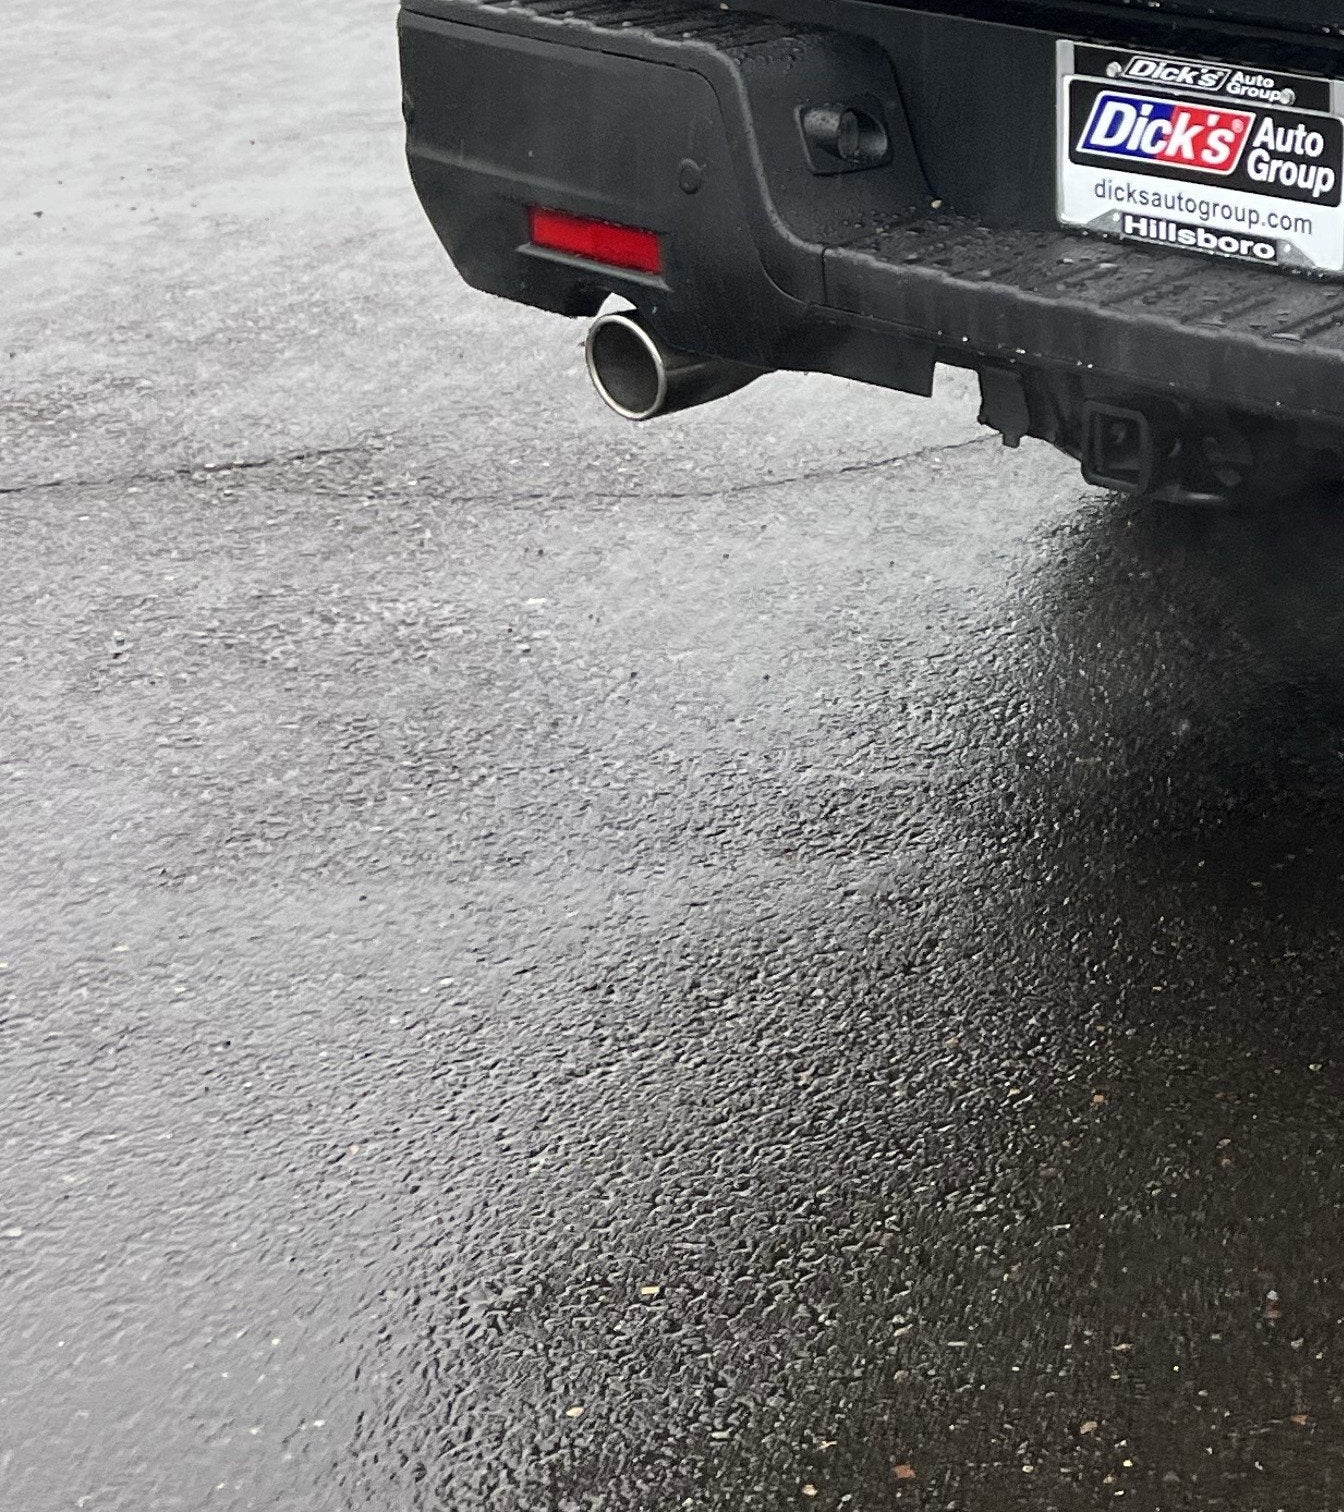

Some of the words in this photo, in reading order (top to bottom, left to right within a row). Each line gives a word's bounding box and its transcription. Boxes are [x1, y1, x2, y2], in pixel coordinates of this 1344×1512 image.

[1129, 59, 1220, 88] Dick's
[1230, 70, 1275, 88] Auto
[1226, 82, 1283, 102] Group
[1089, 99, 1236, 166] Dick's
[1252, 117, 1325, 157] Auto
[1247, 148, 1336, 198] Group
[1094, 178, 1312, 235] dicksautogroup.com
[1123, 215, 1276, 260] Hillsboro
